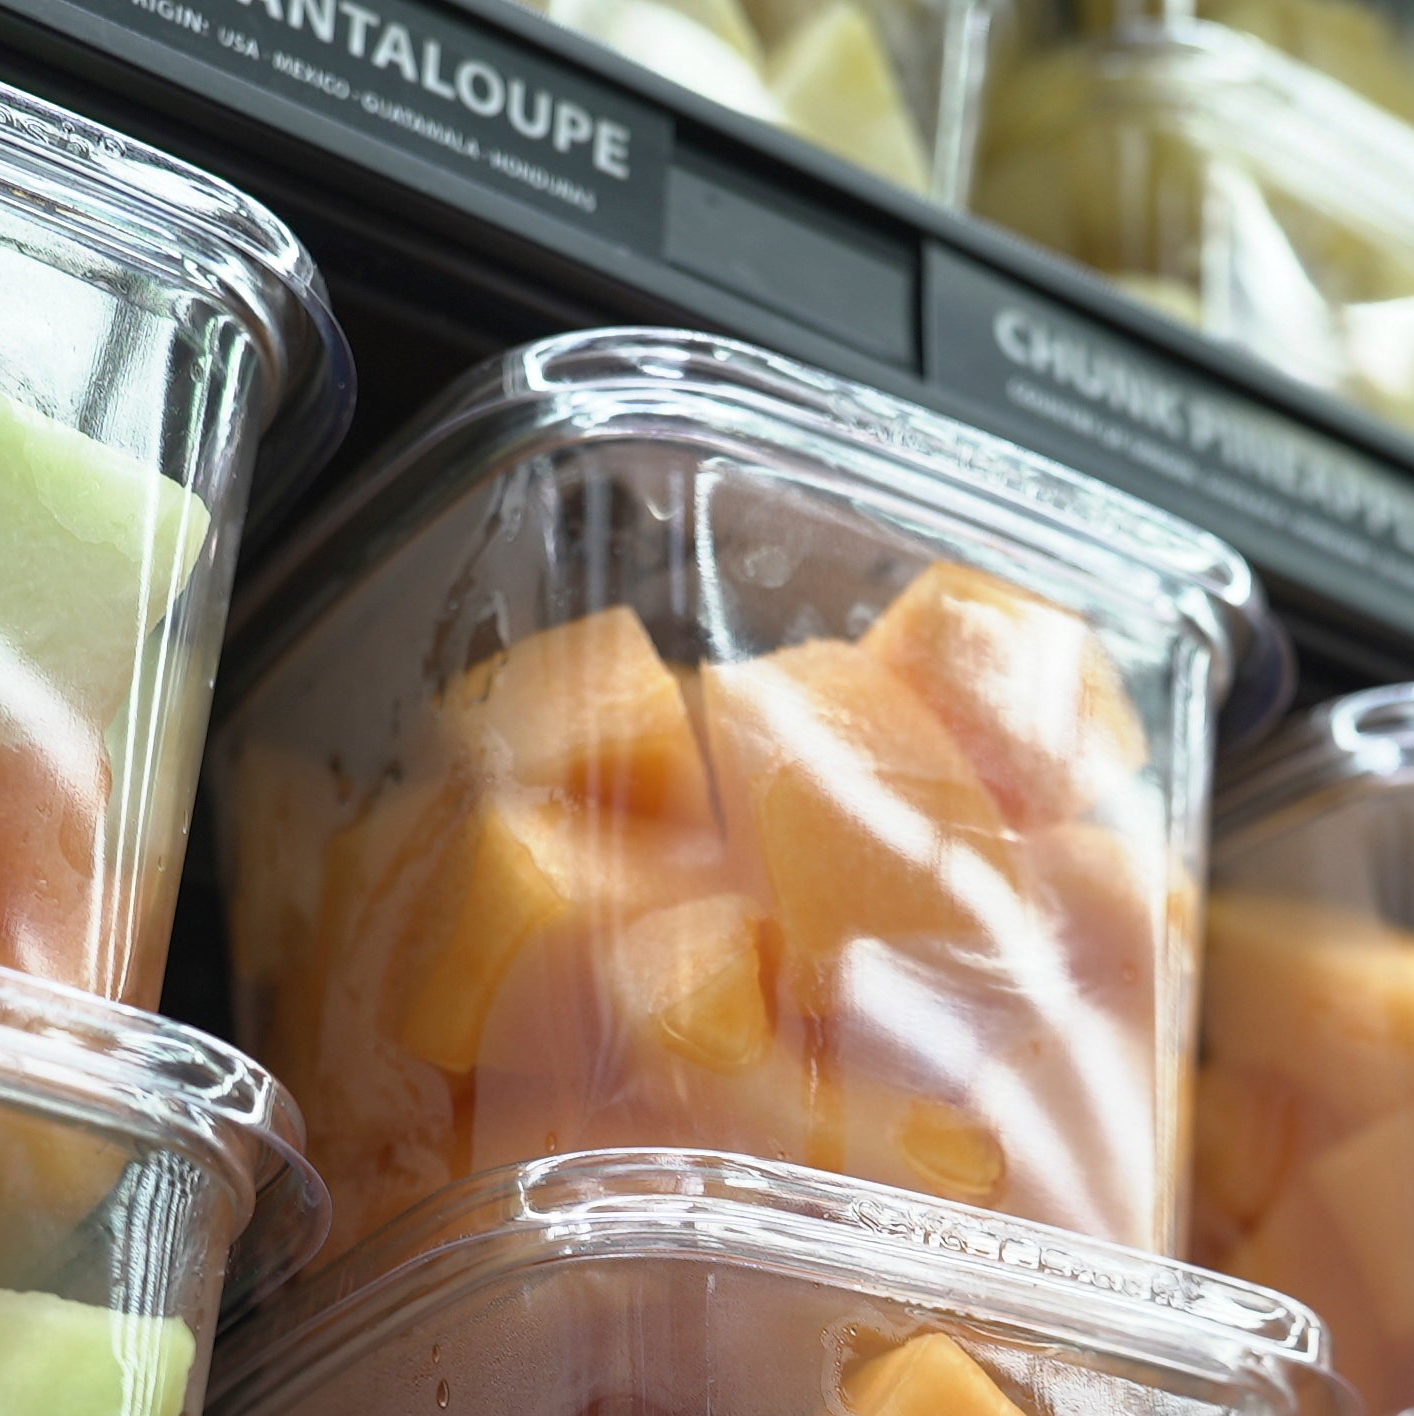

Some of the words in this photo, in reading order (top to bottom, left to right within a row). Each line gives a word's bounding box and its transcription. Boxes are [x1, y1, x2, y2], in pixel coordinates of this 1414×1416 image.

[217, 26, 260, 60] USA
[271, 50, 350, 100] MEXICO
[992, 308, 1185, 440] CHUNK
